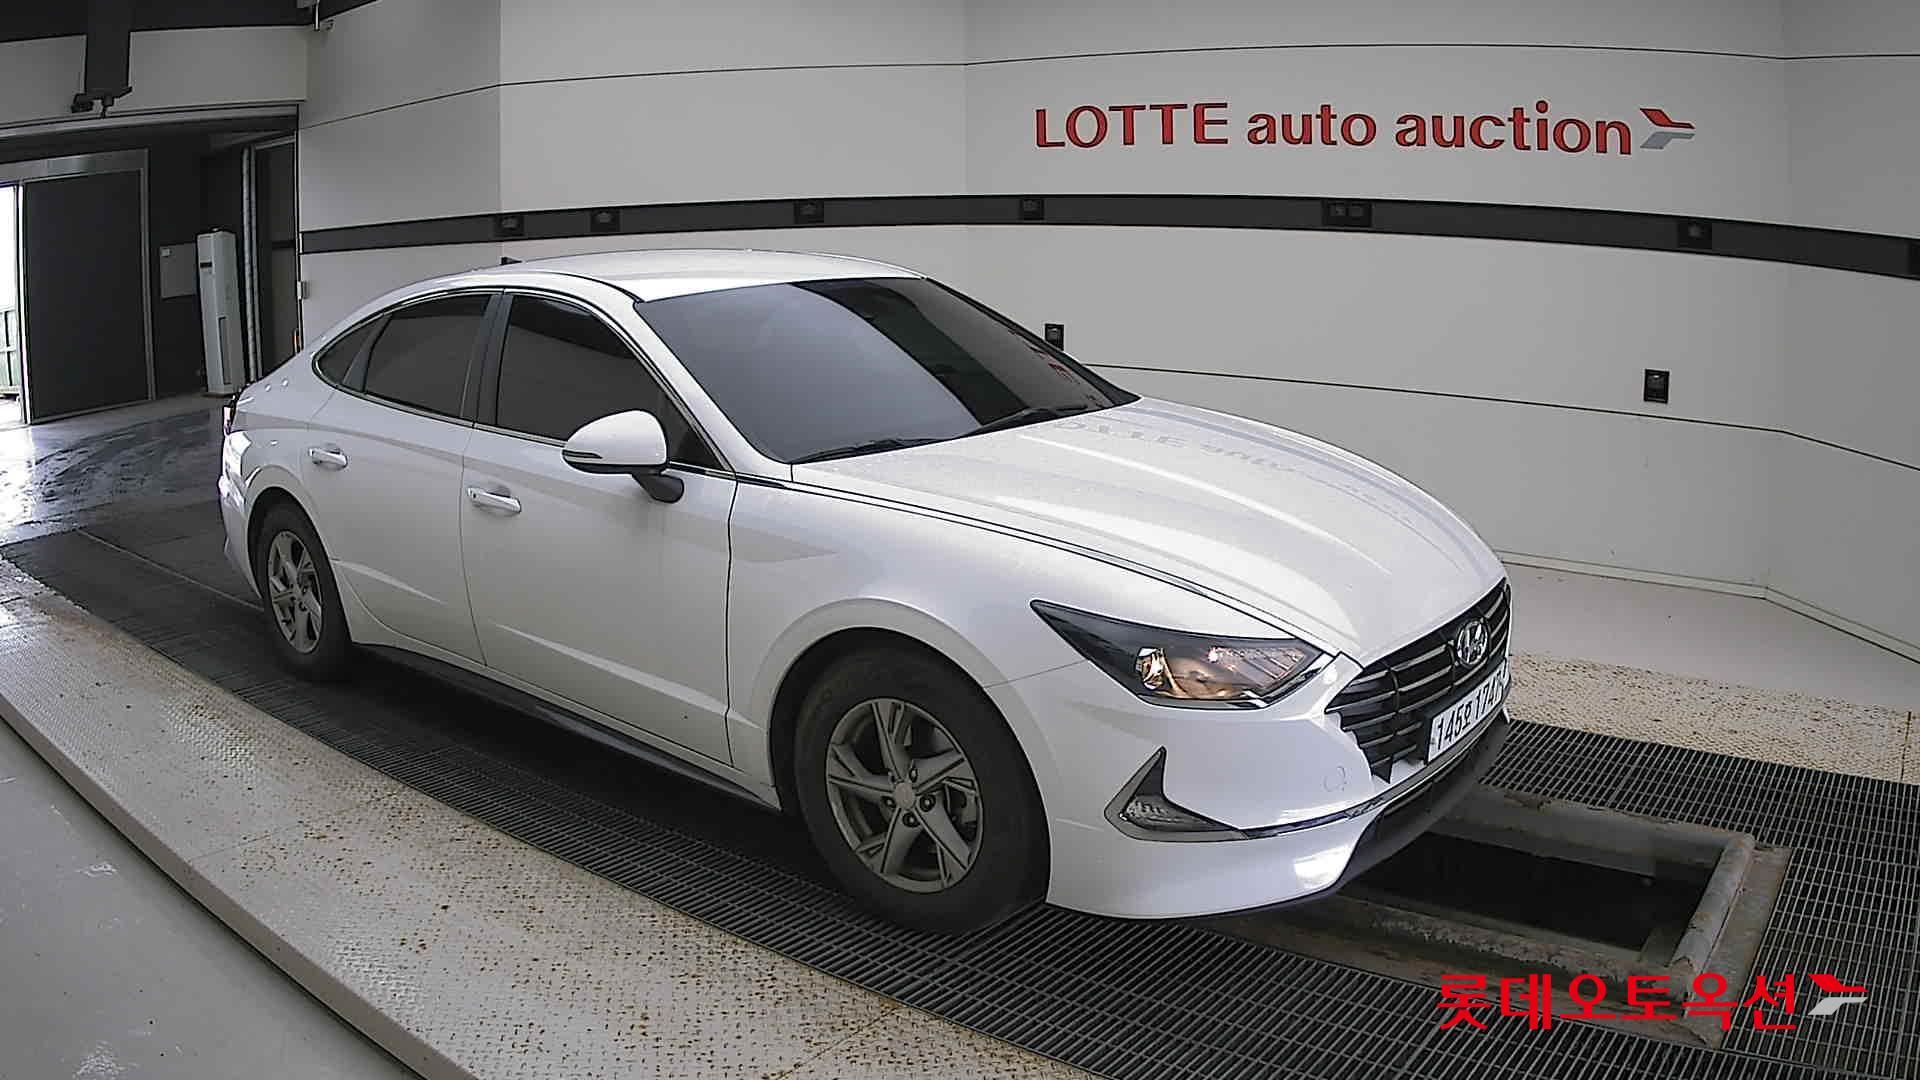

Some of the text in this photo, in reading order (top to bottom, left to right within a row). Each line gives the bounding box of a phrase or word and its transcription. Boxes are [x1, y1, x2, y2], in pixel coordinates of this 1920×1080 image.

[1035, 101, 1632, 155] LOTTE auto auction
